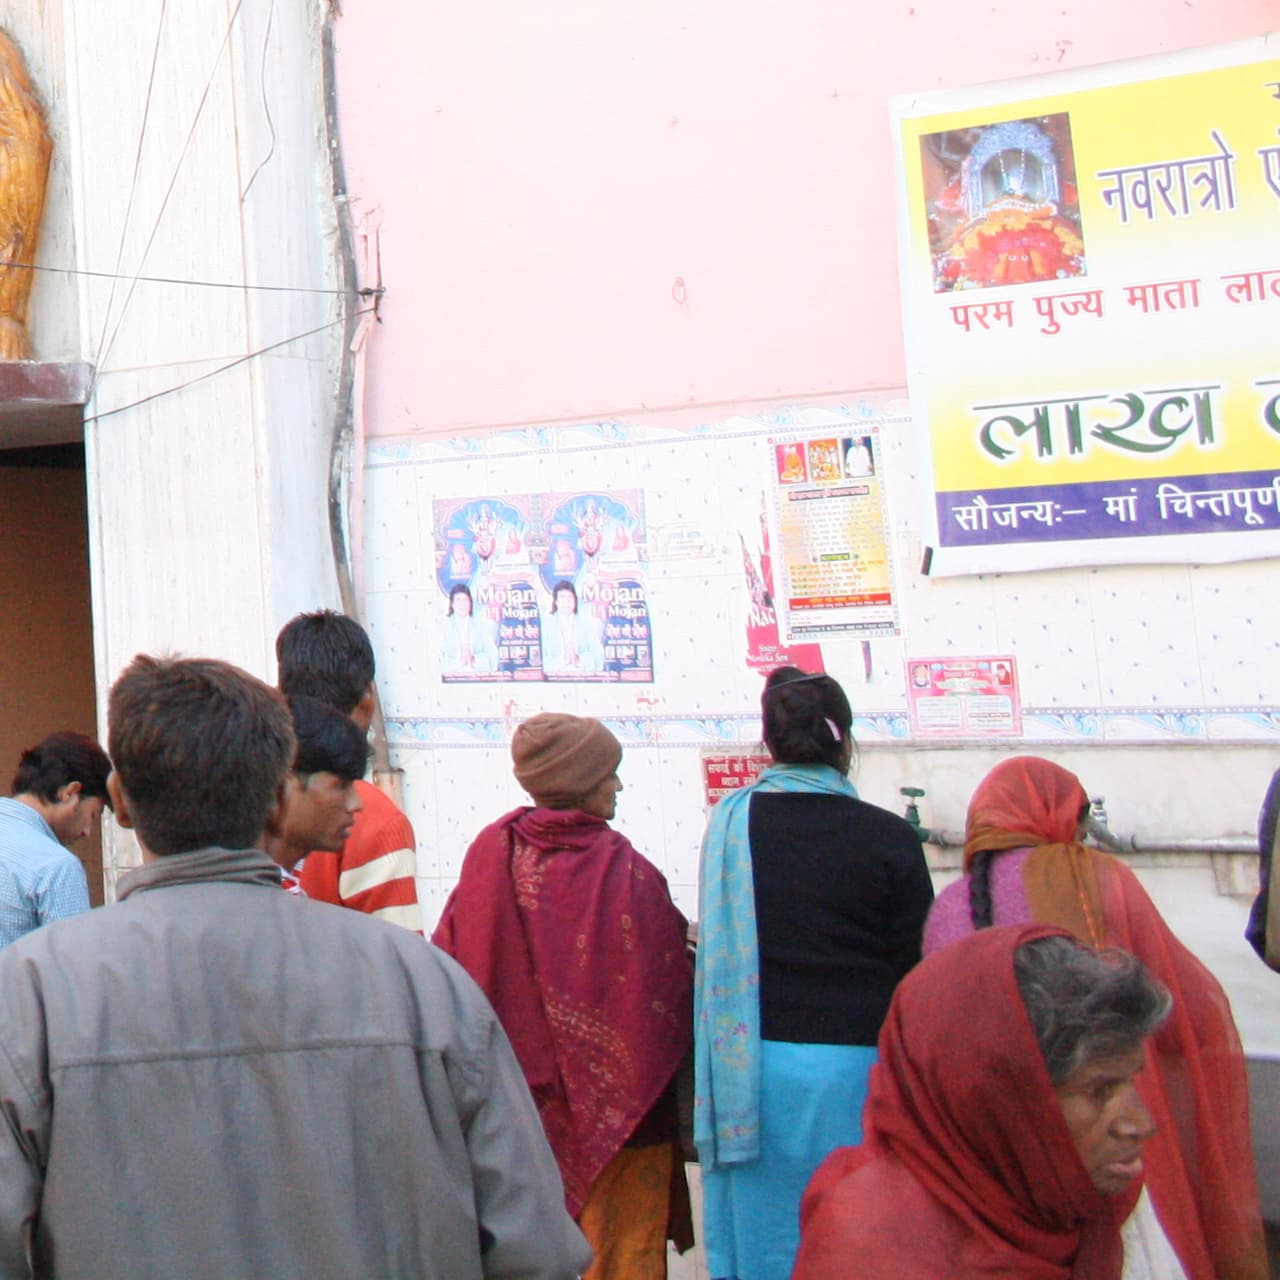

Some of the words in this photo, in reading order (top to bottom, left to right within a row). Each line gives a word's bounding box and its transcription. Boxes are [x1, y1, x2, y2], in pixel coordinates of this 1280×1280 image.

[950, 300, 1013, 332] परम
[1032, 289, 1104, 335] पुज्य
[1123, 279, 1201, 313] माता
[1105, 489, 1137, 523] मां
